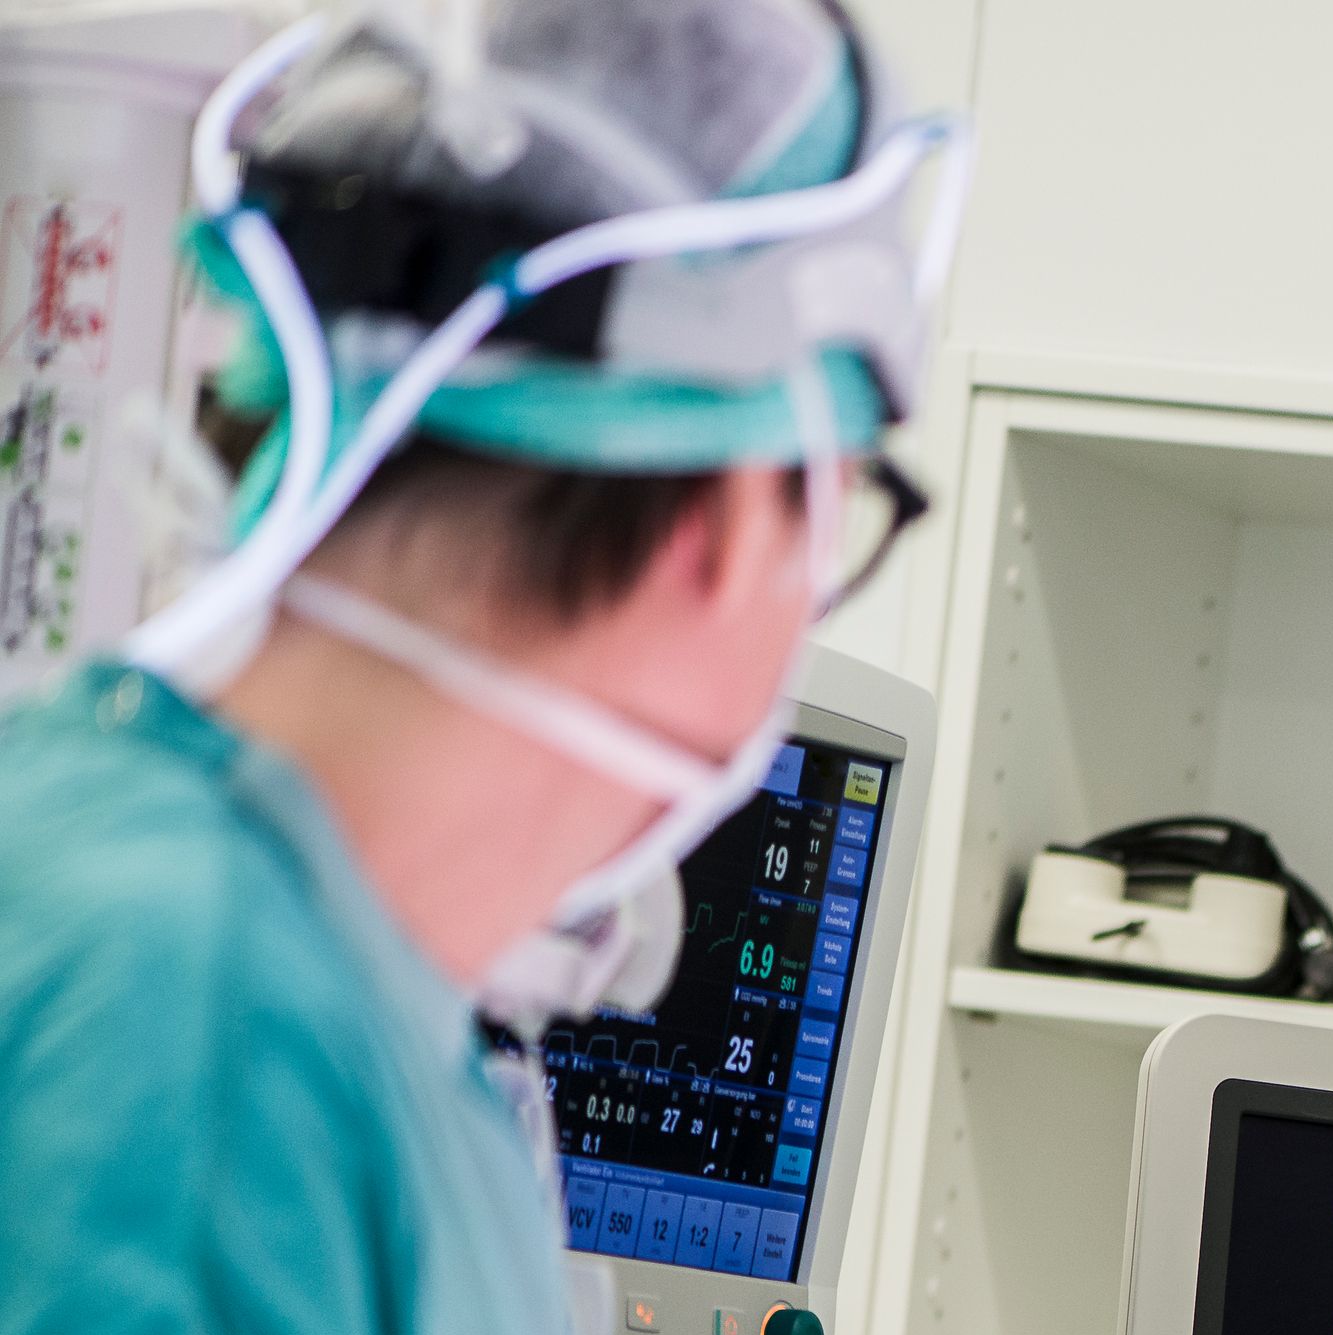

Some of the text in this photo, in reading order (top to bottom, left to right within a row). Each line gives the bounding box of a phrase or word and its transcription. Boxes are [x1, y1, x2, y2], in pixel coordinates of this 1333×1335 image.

[809, 838, 820, 855] 11
[765, 844, 788, 881] 19
[803, 880, 811, 894] 7
[740, 939, 774, 979] 6.9
[780, 975, 797, 992] 581
[724, 1036, 753, 1073] 25
[767, 1071, 775, 1086] 0
[586, 1093, 636, 1125] 0.3 0.0
[660, 1108, 681, 1133] 27
[582, 1131, 601, 1155] 0.1
[568, 1206, 594, 1230] VCV
[608, 1211, 632, 1235] 550
[653, 1218, 668, 1241] 12
[690, 1224, 709, 1247] 1:2
[732, 1231, 742, 1252] 7
